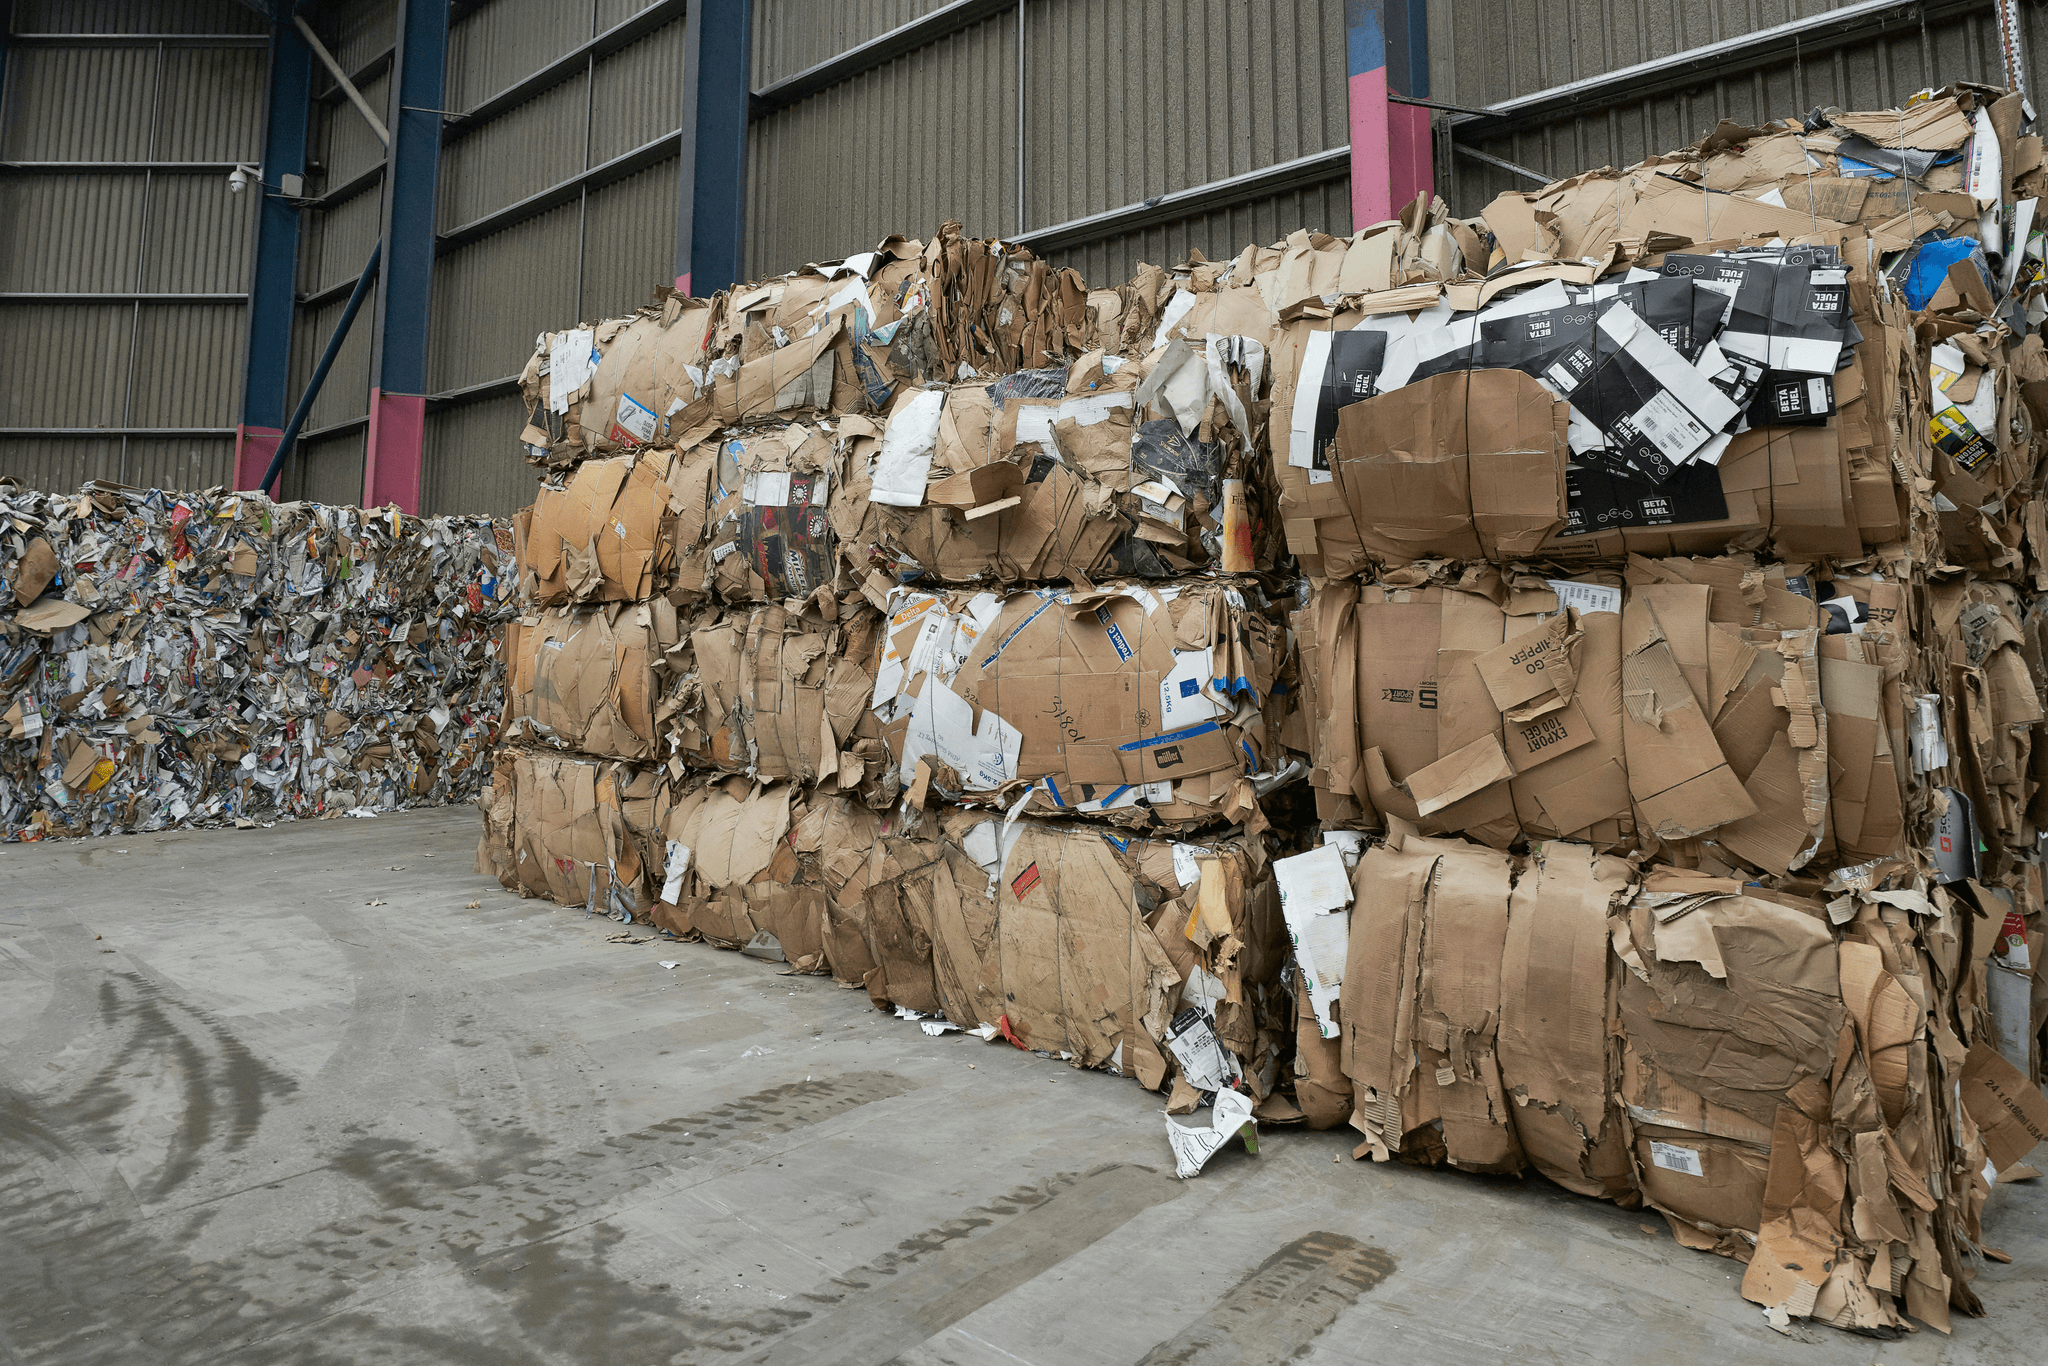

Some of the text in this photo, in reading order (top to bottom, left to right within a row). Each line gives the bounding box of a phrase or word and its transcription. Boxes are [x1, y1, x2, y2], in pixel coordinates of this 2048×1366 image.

[1719, 269, 1744, 278] FUEL
[1811, 301, 1838, 311] BETA
[1814, 293, 1839, 301] FUEL
[1529, 320, 1551, 331] FUEL
[1529, 328, 1552, 338] BETA
[1669, 327, 1678, 349] FUEL
[1568, 355, 1586, 374] FUEL
[1574, 349, 1594, 368] BETA
[1354, 374, 1363, 394] BETA
[1361, 374, 1370, 394] FUEL
[1778, 388, 1790, 412] BETA
[1790, 387, 1801, 411] FUEL
[1615, 422, 1635, 442] FUEL
[1620, 415, 1641, 436] BETA
[1643, 500, 1668, 508] BETA
[1645, 507, 1669, 516] FUEL
[901, 606, 921, 620] Delta
[1509, 637, 1553, 666] HIPPER
[1526, 659, 1545, 675] GO
[1520, 717, 1562, 741] 100 GEL
[1527, 726, 1569, 754] EXPORT
[1984, 1079, 2044, 1142] 24 x 6x60ml USA
